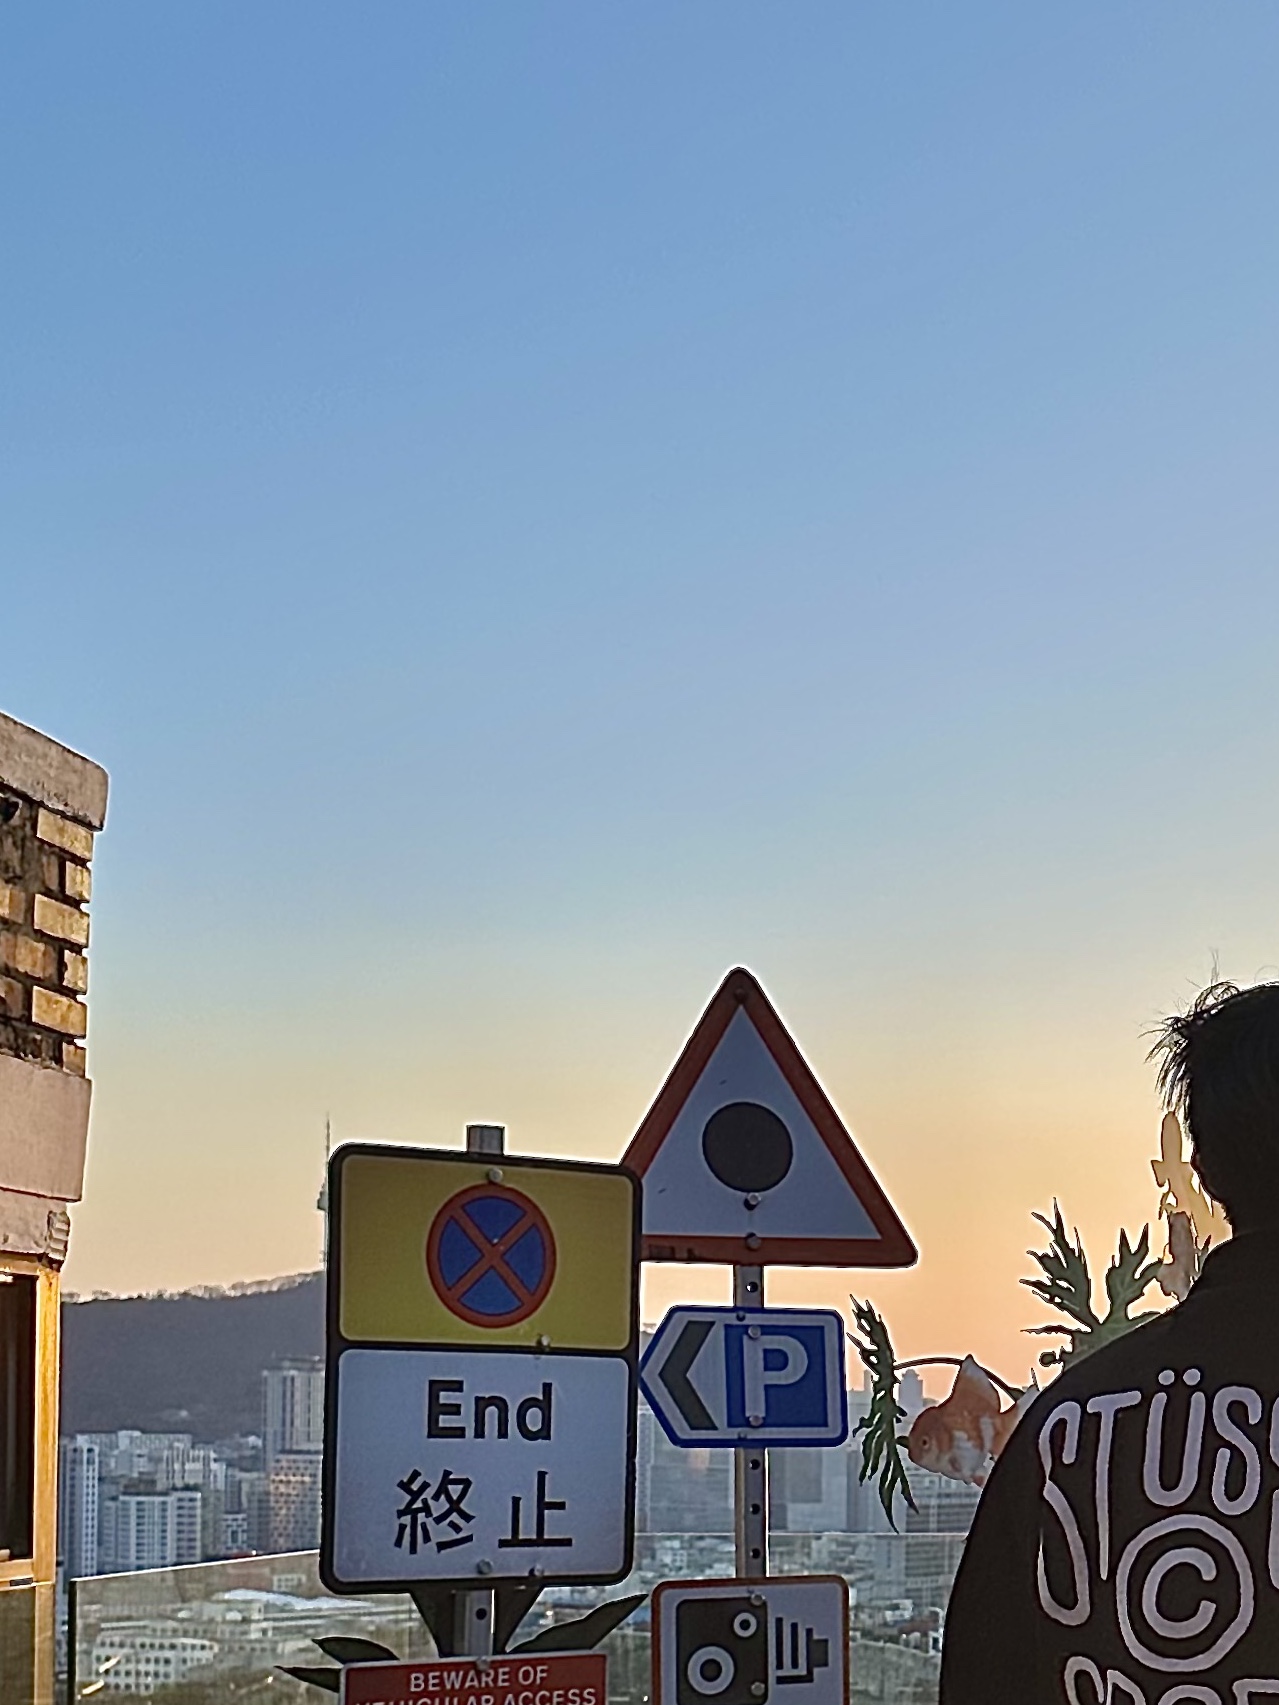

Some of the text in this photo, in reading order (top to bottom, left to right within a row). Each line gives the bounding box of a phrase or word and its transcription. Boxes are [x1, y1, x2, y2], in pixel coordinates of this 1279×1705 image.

[427, 1379, 553, 1441] End
[394, 1469, 573, 1554] 終止
[410, 1665, 549, 1692] BEWARE OF
